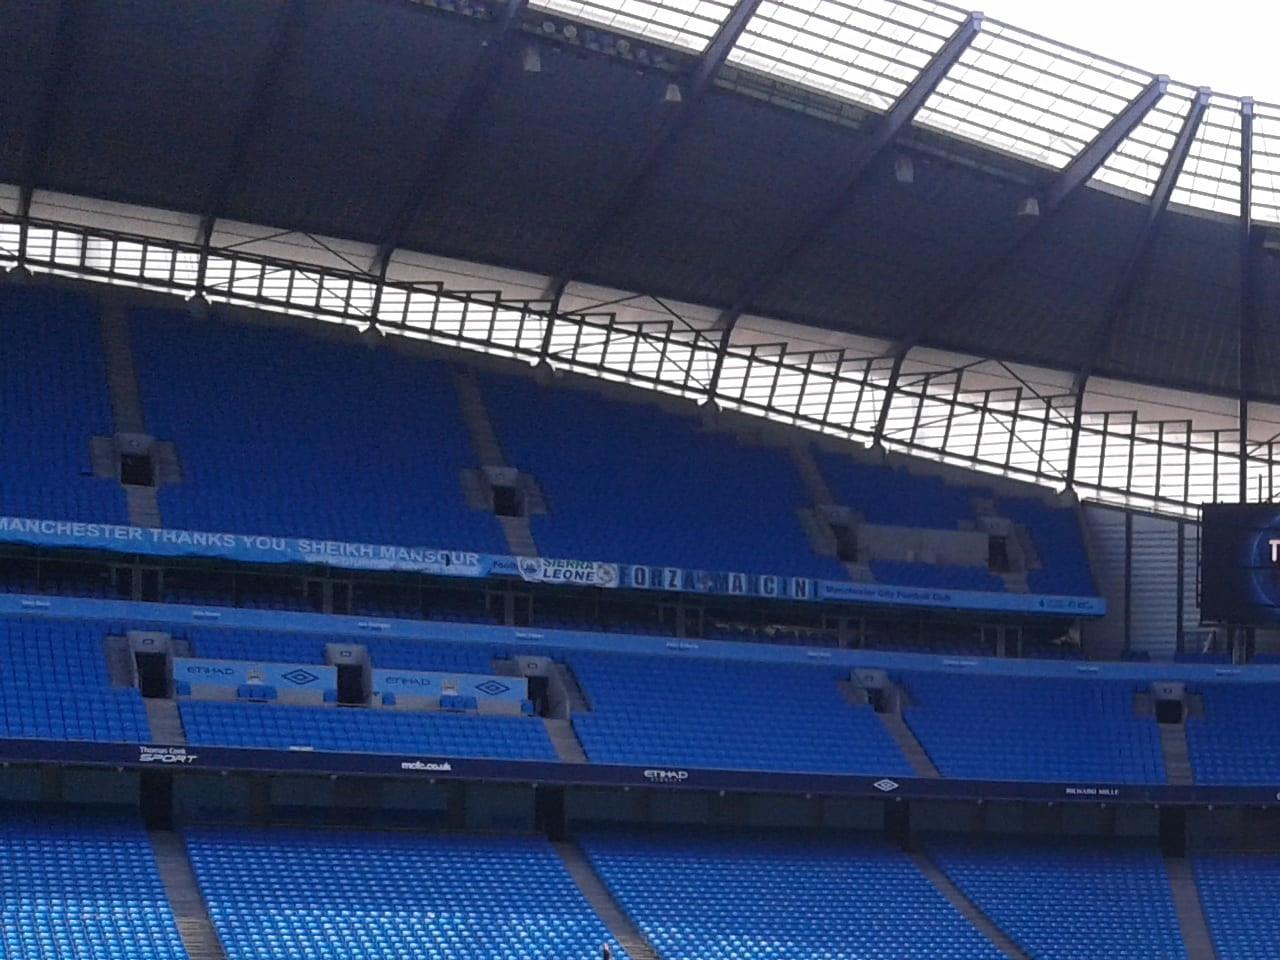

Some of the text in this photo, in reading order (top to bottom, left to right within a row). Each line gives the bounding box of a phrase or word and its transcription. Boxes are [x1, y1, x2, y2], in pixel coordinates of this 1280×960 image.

[151, 528, 236, 548] THANKS
[299, 540, 373, 557] SHEIKH
[380, 545, 480, 566] MANSOUR
[543, 558, 595, 571] SIERRA
[542, 569, 596, 583] LEONE
[619, 566, 820, 600] FORZA MANCINI
[187, 666, 235, 676] ETIHAD
[385, 676, 431, 687] ETIHAD
[139, 753, 198, 763] SPORT
[643, 769, 689, 779] ETIHAD
